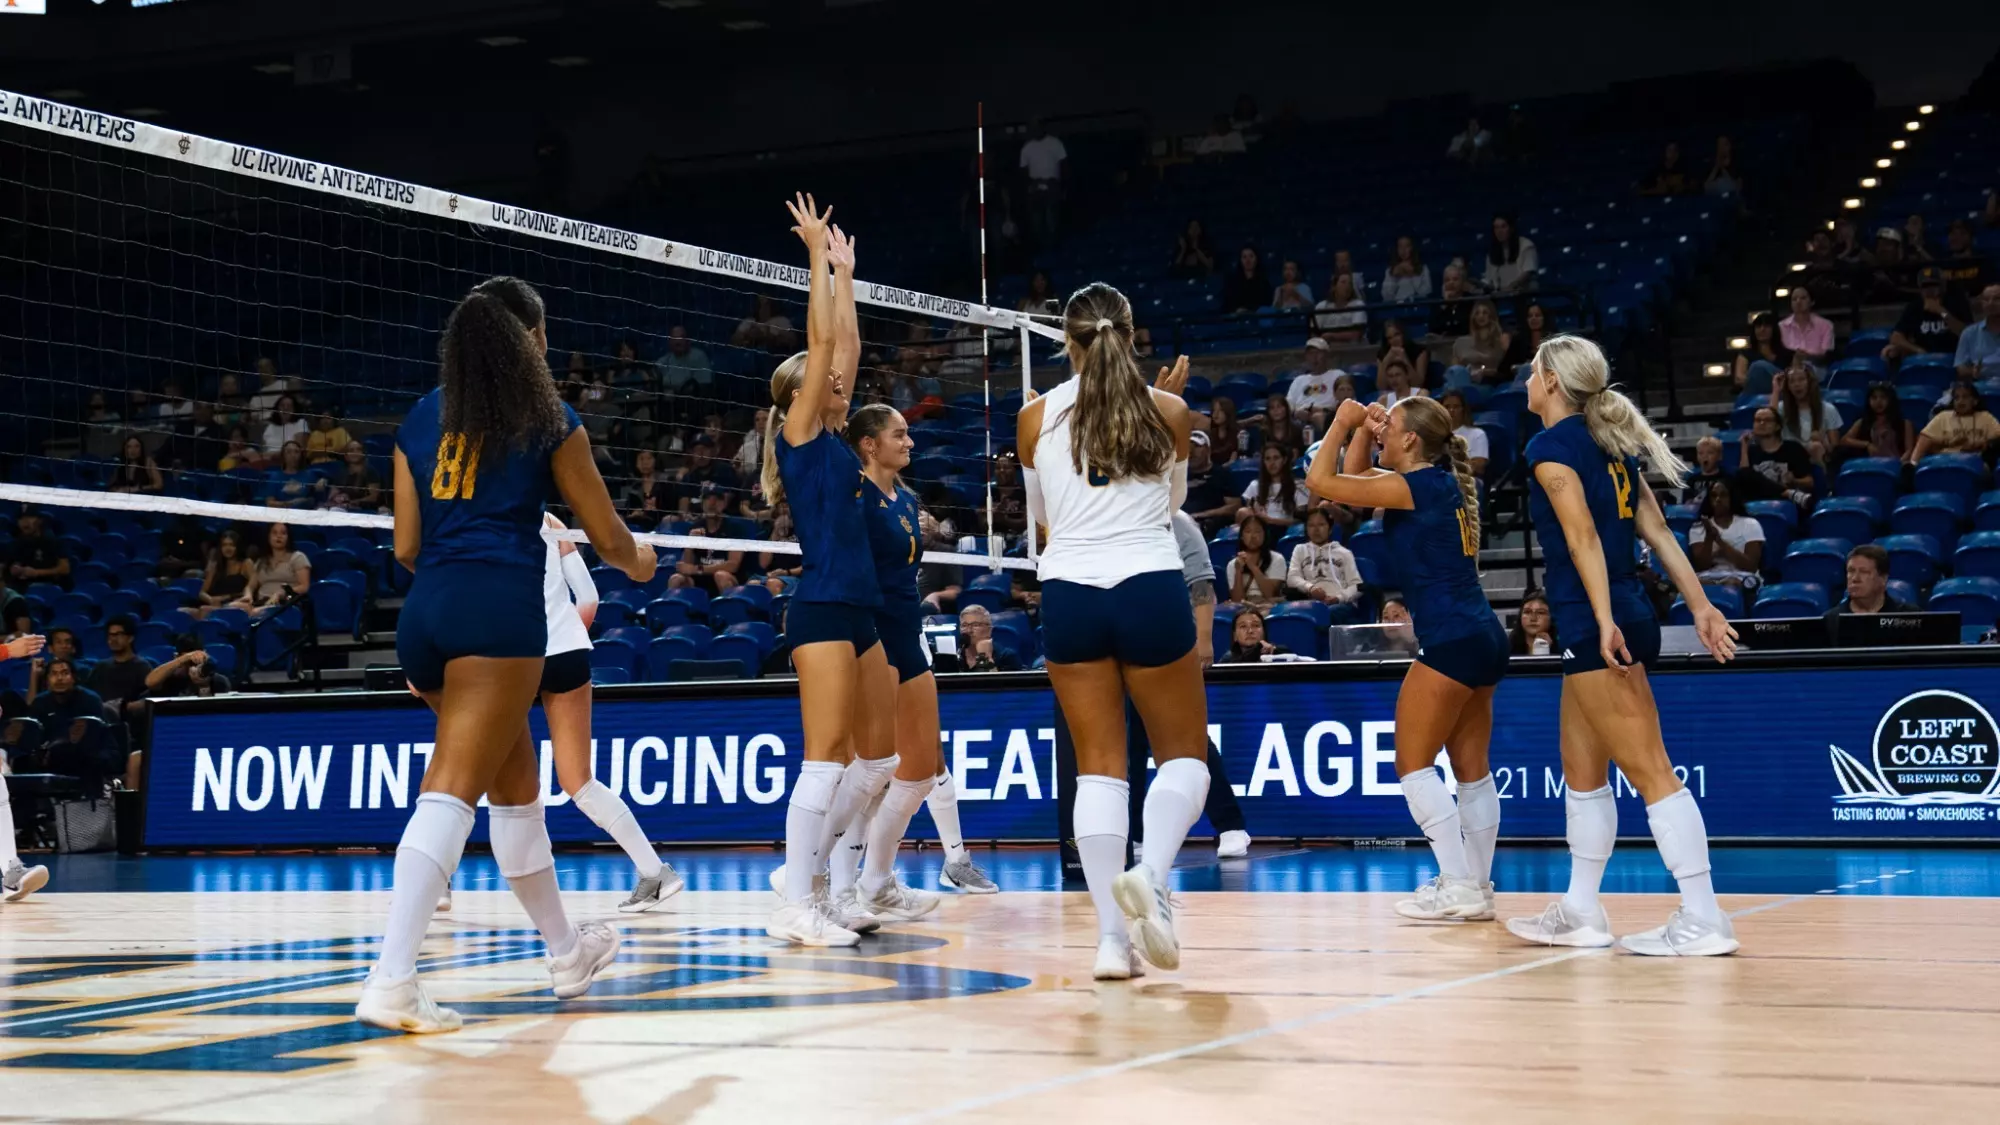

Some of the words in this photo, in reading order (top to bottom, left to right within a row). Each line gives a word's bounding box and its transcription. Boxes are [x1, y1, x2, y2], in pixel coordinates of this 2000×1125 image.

[13, 96, 136, 143] ANTEATERS
[231, 146, 257, 170] UC
[257, 152, 318, 184] IRVINE
[320, 166, 416, 204] ANTEATERS
[492, 203, 511, 224] UC
[513, 208, 559, 235] IRVINE
[560, 221, 639, 251] ANTEATERS
[698, 248, 715, 267] UC
[716, 252, 755, 275] IRVINE
[756, 262, 811, 287] ANTEATE
[869, 283, 883, 300] UC
[885, 287, 916, 307] IRVINE
[917, 294, 970, 318] ANTEATERS
[1608, 461, 1633, 519] 12
[1899, 718, 1977, 739] LEFT
[191, 745, 334, 812] NOW
[350, 734, 786, 809] INTDUCING
[1890, 744, 1988, 765] COAST
[1496, 766, 1528, 799] 21
[1897, 773, 1959, 784] BREWING
[1961, 773, 1982, 784] CO.
[1832, 807, 1873, 821] TASTING
[1875, 807, 1906, 821] ROOM
[1916, 807, 1985, 821] SMOKEHOUSE
